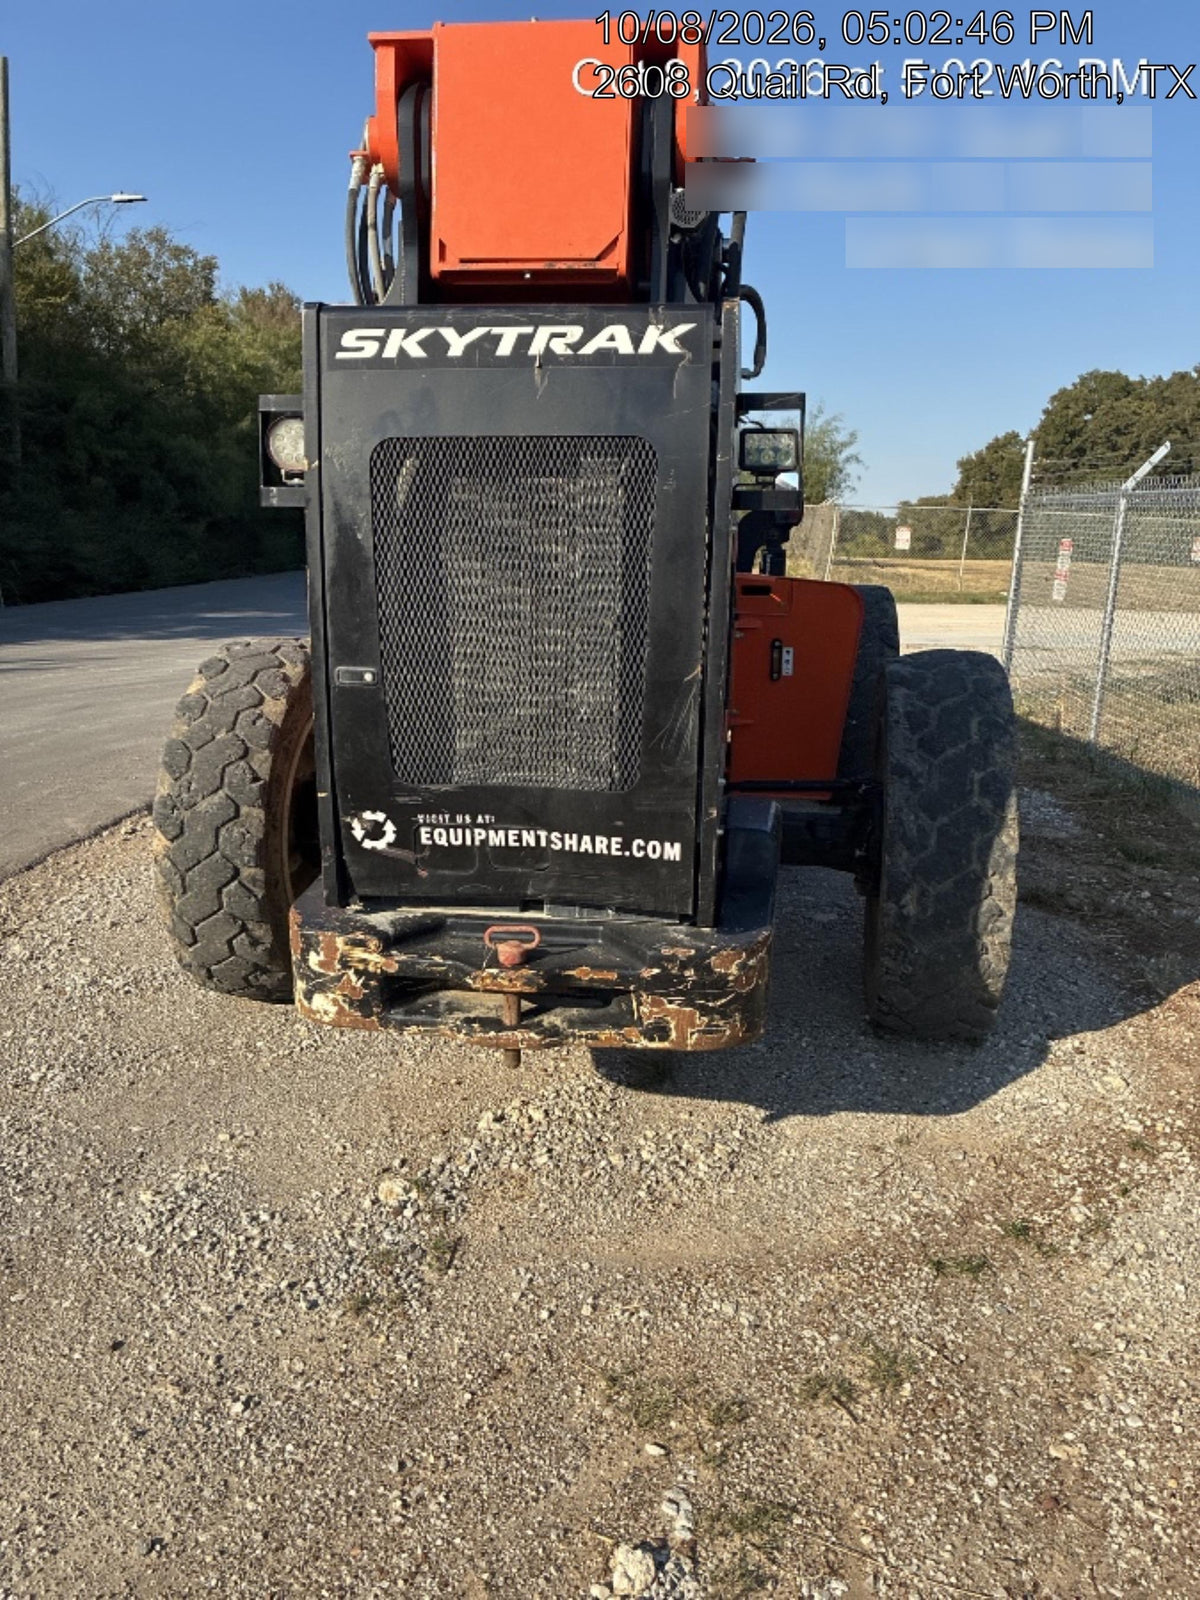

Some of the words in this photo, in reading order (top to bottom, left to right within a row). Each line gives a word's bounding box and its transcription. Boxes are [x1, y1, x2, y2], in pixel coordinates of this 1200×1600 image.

[335, 322, 698, 360] SKYTRAK
[456, 813, 472, 824] US
[420, 826, 682, 861] EQUIPMENTSHARE.COM
